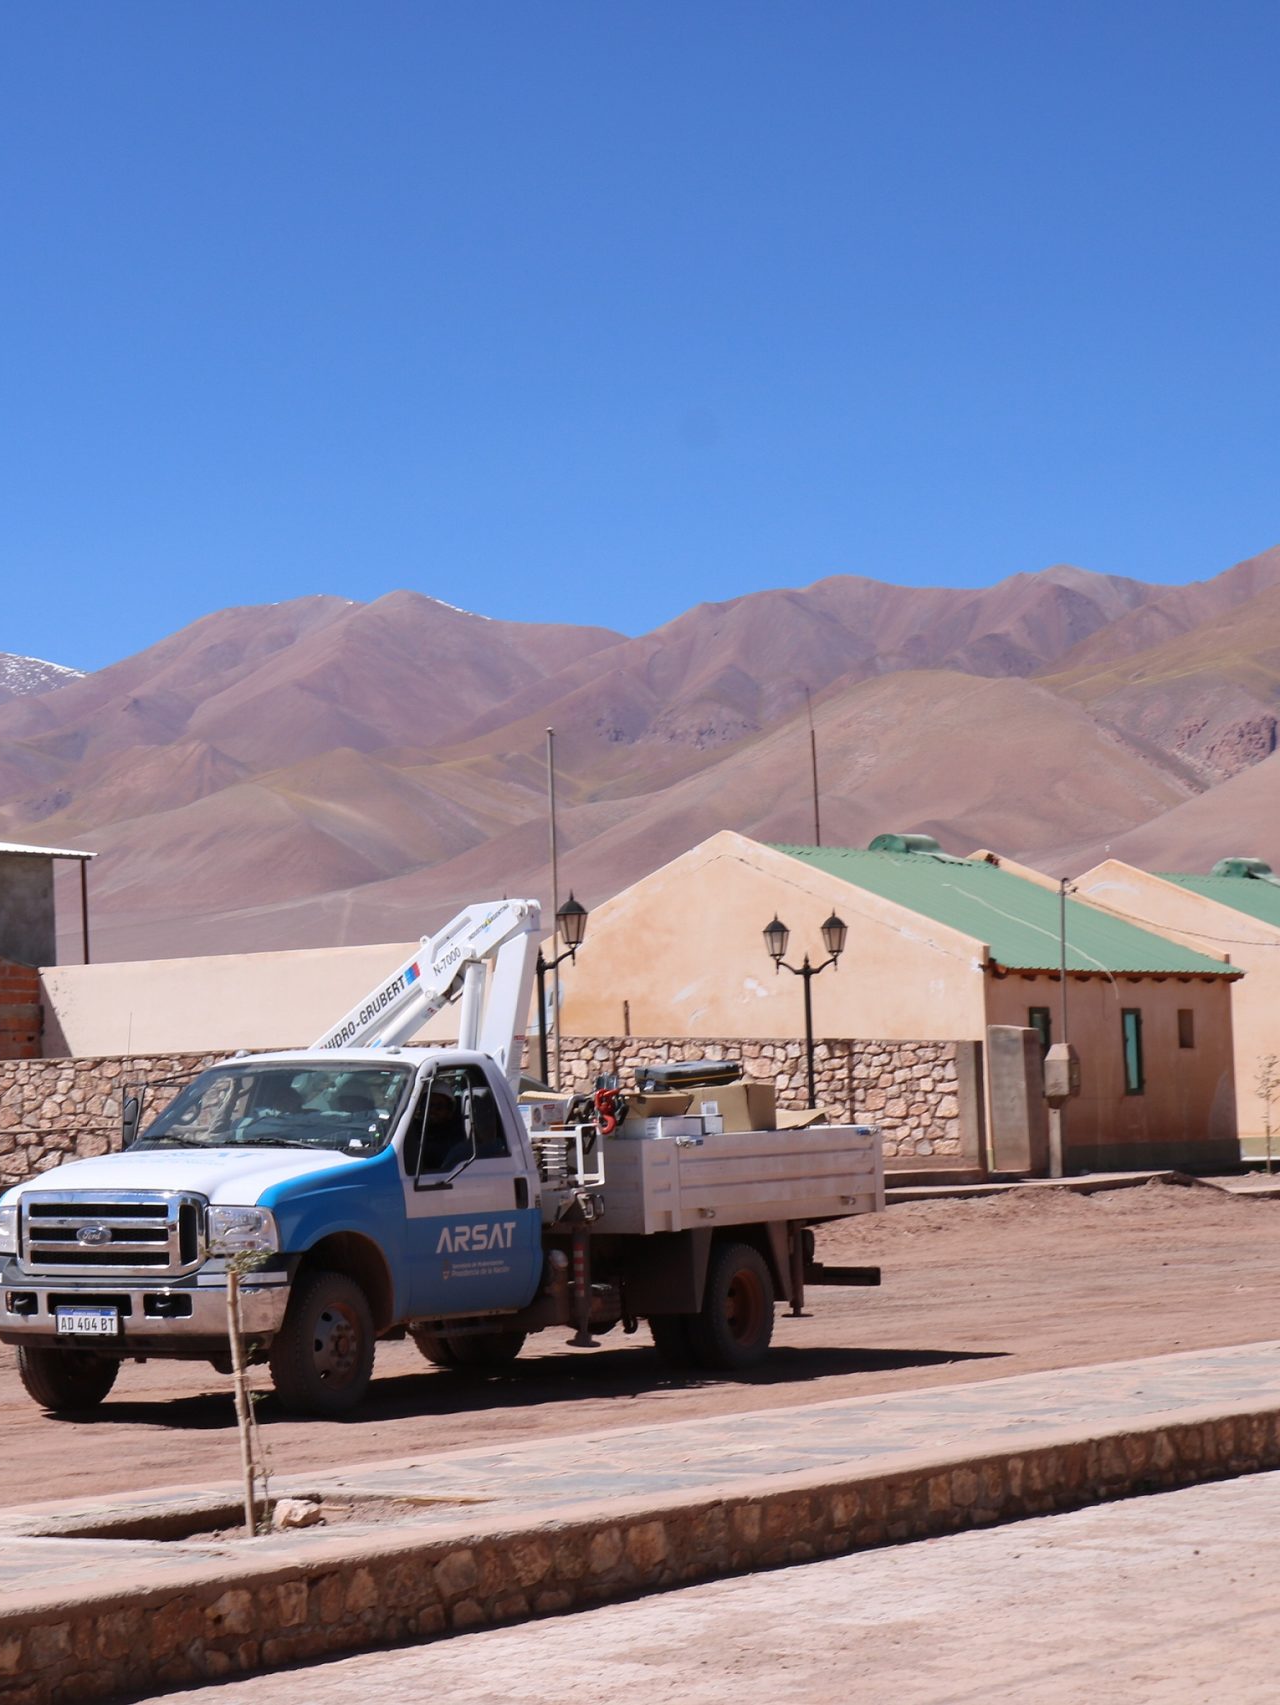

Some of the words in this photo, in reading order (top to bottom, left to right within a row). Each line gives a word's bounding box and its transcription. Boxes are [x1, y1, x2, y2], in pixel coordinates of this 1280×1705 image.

[433, 947, 461, 976] N-7000
[82, 1230, 102, 1240] Ford
[436, 1222, 517, 1254] ARSAT
[61, 1317, 74, 1330] AD
[78, 1317, 97, 1331] 404
[101, 1317, 114, 1331] BT
